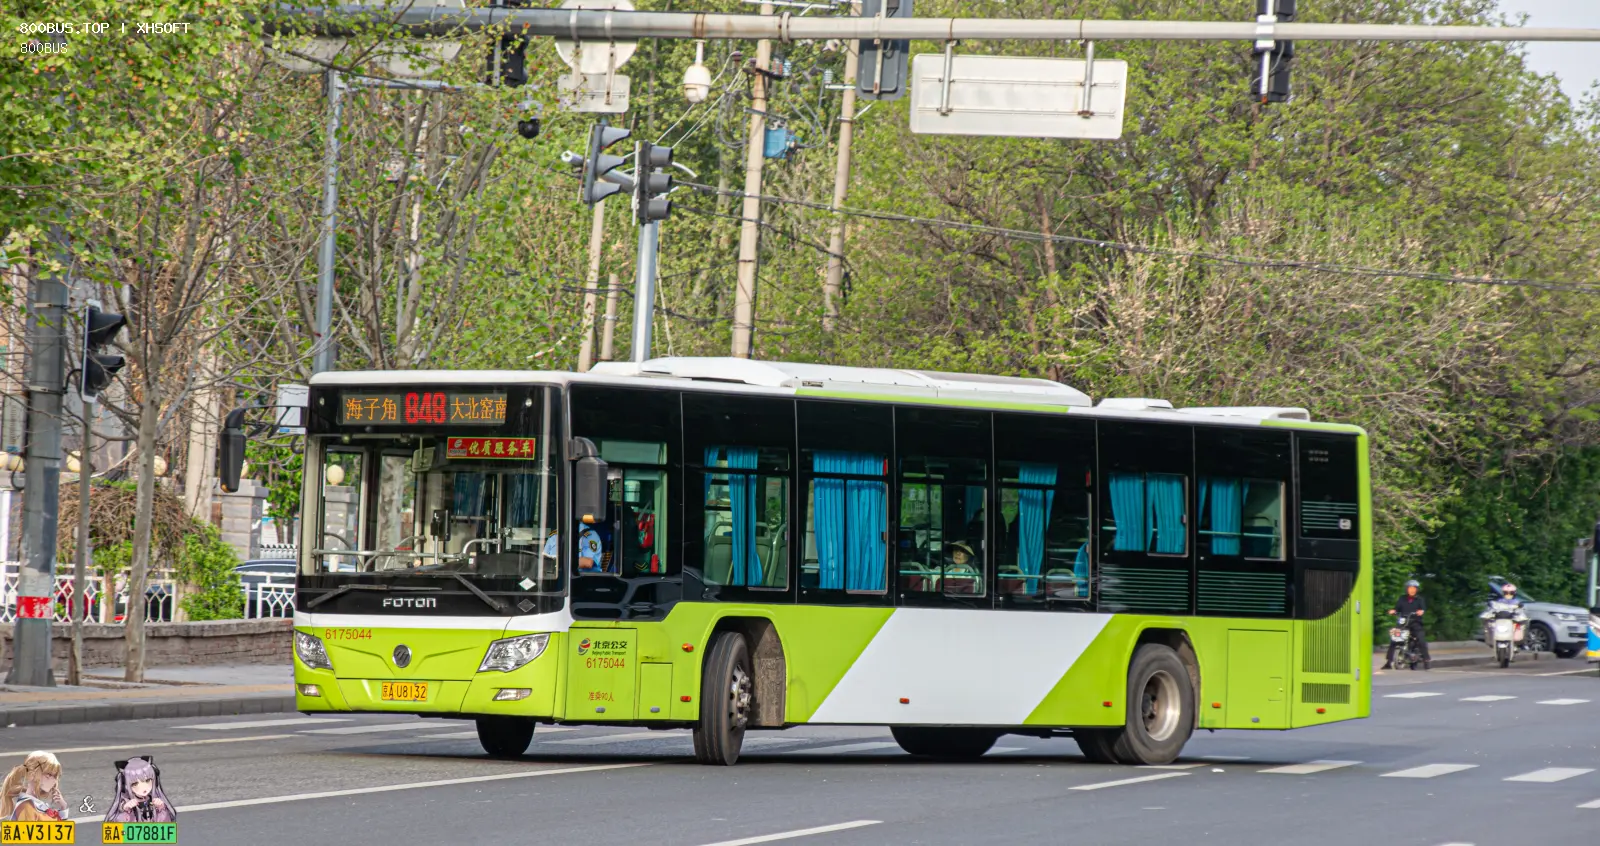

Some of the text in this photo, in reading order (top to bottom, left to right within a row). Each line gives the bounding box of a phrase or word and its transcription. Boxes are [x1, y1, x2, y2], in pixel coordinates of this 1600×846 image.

[345, 392, 507, 424] 海子角 848 大北窑南
[468, 439, 532, 458] 优质服务车
[382, 597, 437, 608] FOTON
[325, 629, 372, 640] 6175044
[593, 640, 628, 649] 北京公交
[586, 657, 625, 669] 6175044
